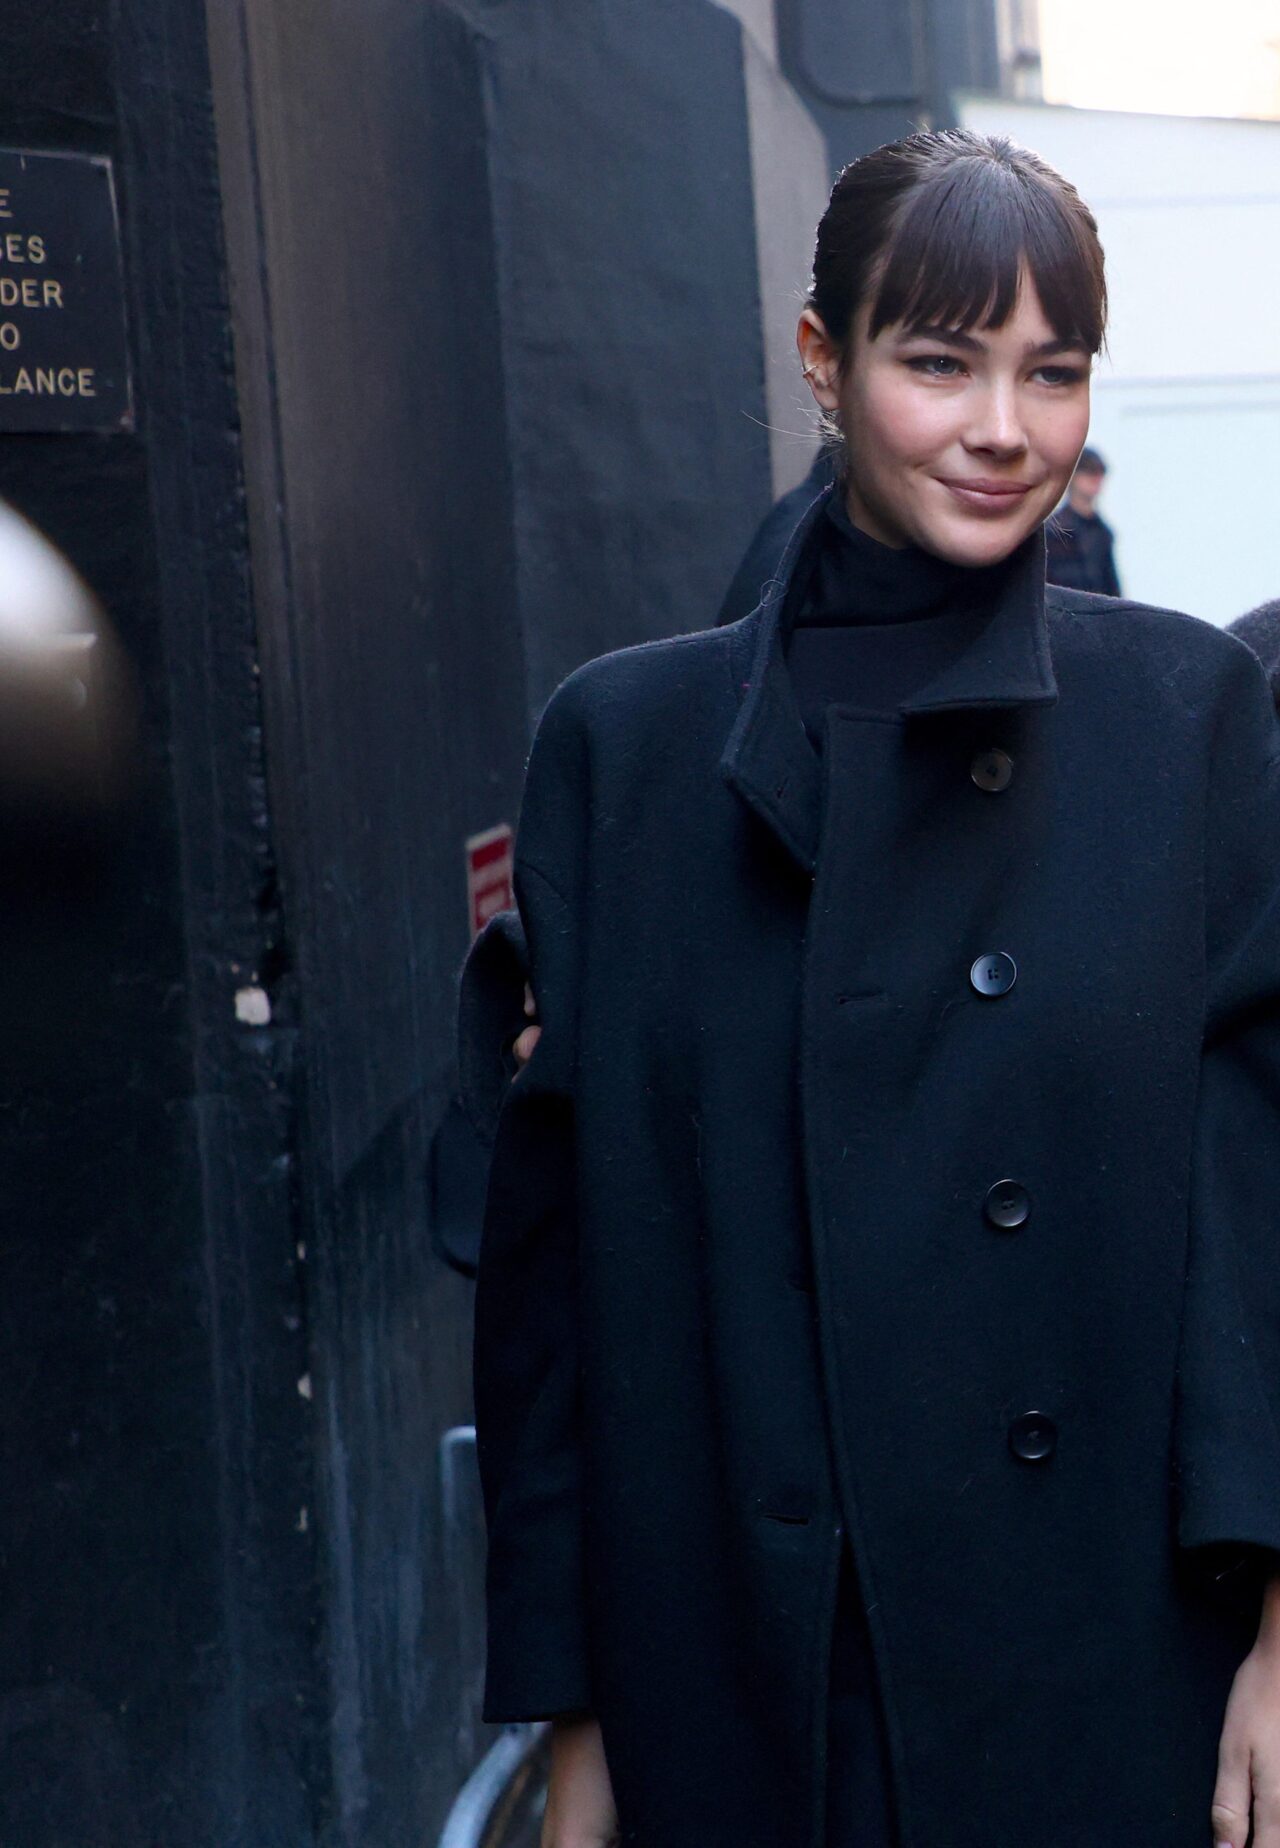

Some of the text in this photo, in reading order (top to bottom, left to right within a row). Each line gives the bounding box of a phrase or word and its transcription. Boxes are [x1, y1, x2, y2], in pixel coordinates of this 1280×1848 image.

[0, 233, 46, 264] ES
[0, 278, 64, 308] DER
[0, 321, 20, 351] O
